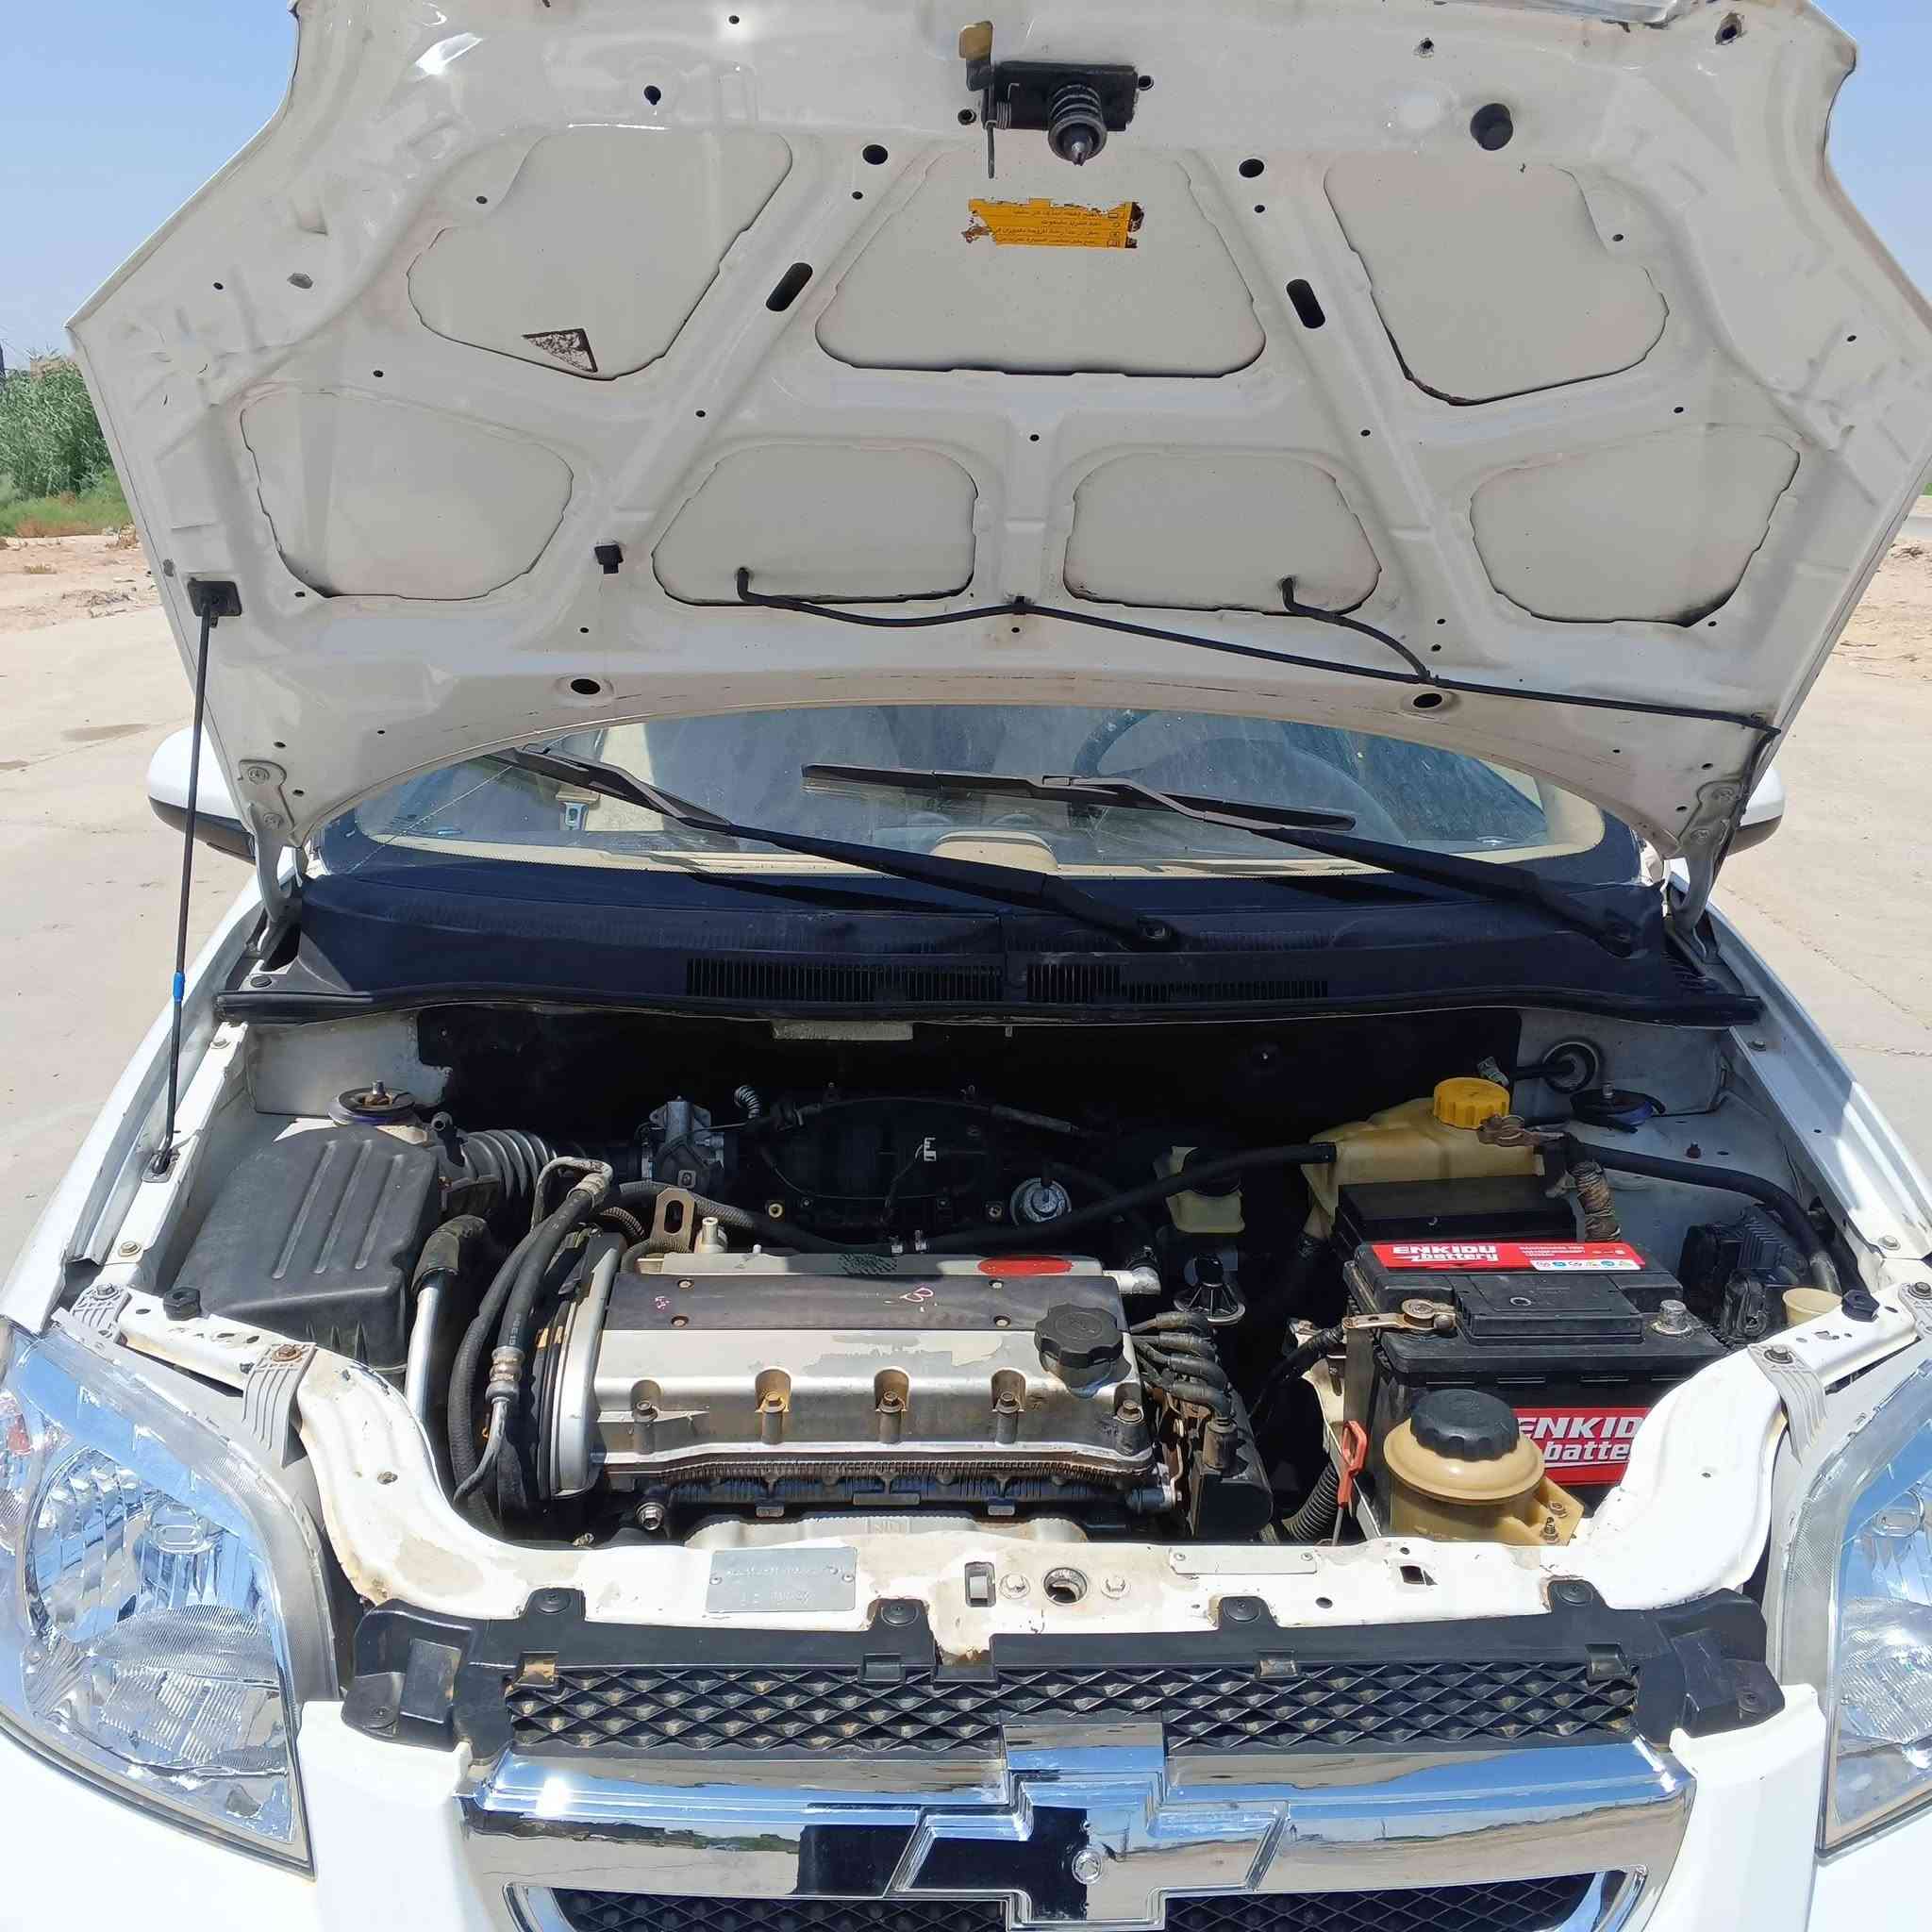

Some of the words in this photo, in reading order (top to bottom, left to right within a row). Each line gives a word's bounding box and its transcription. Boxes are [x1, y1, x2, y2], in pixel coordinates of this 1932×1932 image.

[1392, 1245, 1496, 1254] ENKIDU
[1517, 1417, 1643, 1439] ENKID
[1544, 1441, 1630, 1460] batte
